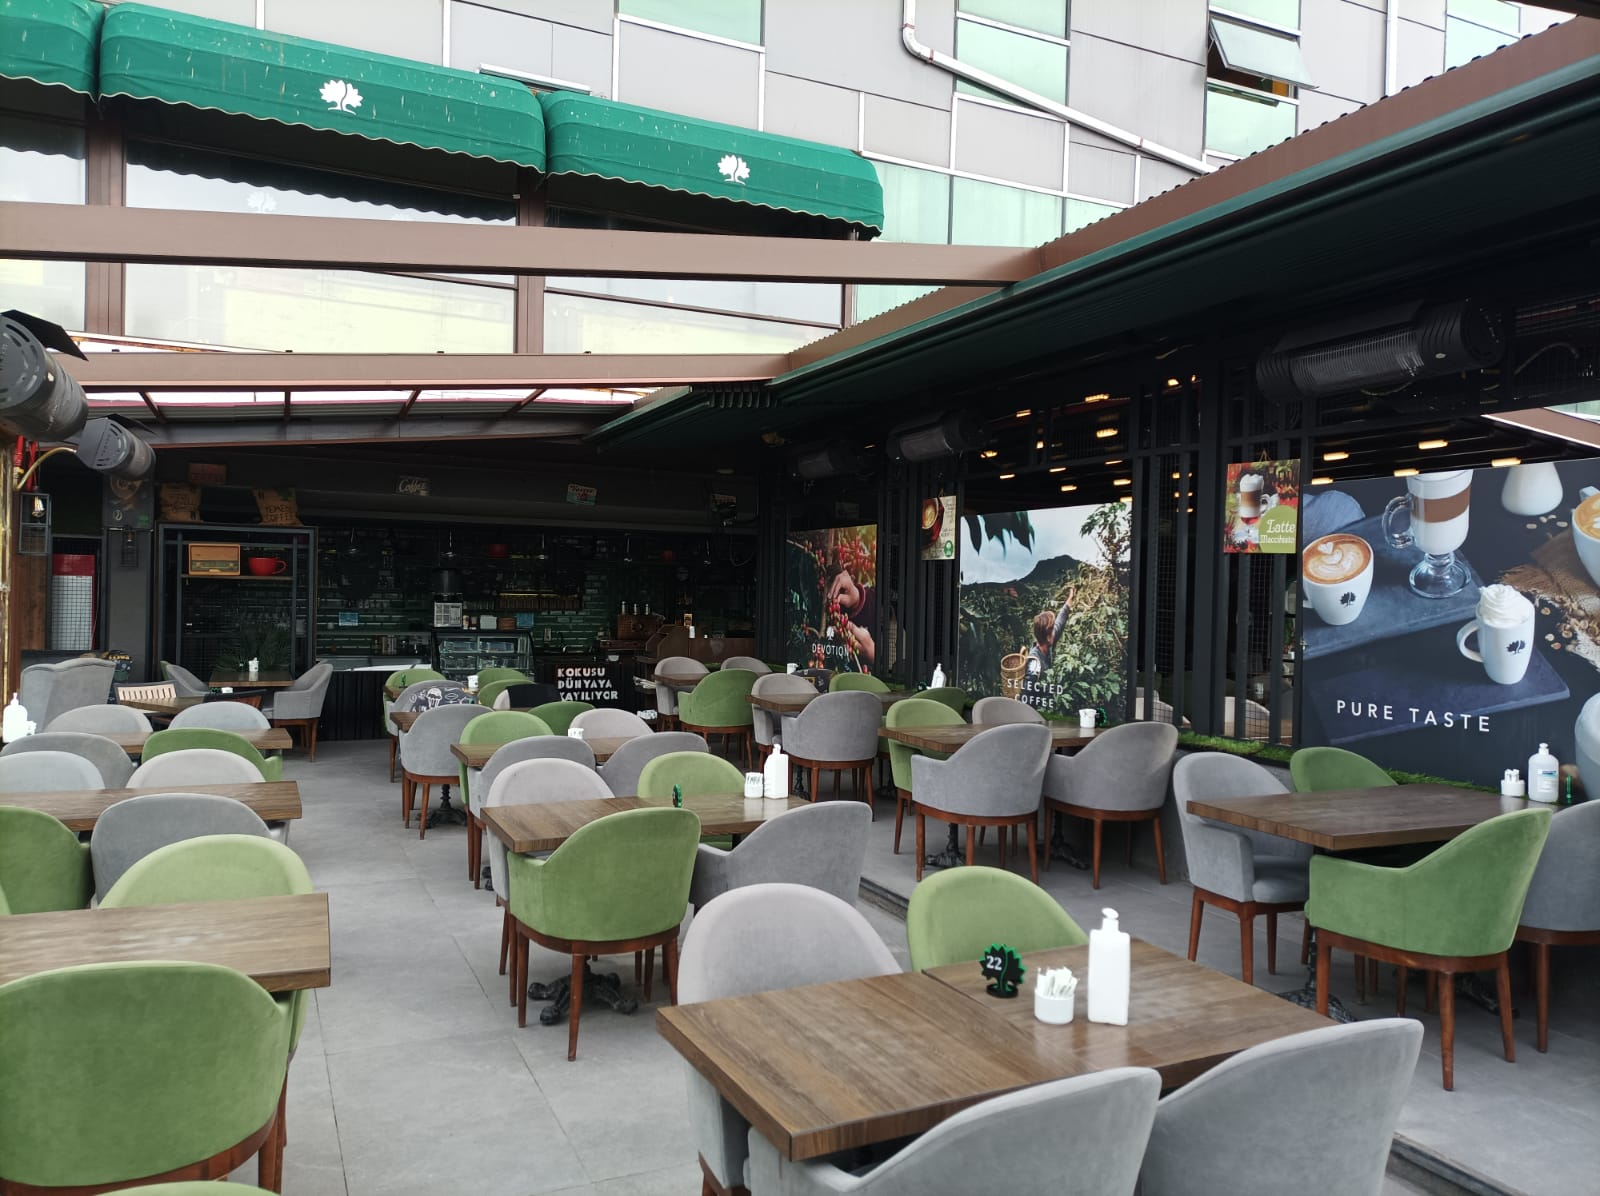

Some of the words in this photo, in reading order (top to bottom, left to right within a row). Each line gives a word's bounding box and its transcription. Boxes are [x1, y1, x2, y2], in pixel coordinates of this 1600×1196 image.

[1266, 519, 1296, 533] Latte
[811, 642, 849, 657] DEVOTION
[557, 667, 605, 677] KOKUSU
[557, 678, 612, 689] DÜNYAYA
[1007, 678, 1064, 695] SELECTED
[559, 690, 618, 701] YAYILIYOR
[1014, 693, 1054, 708] COFFEE
[1336, 699, 1393, 721] PURE
[1409, 708, 1491, 732] TASTE
[986, 955, 1003, 970] 22
